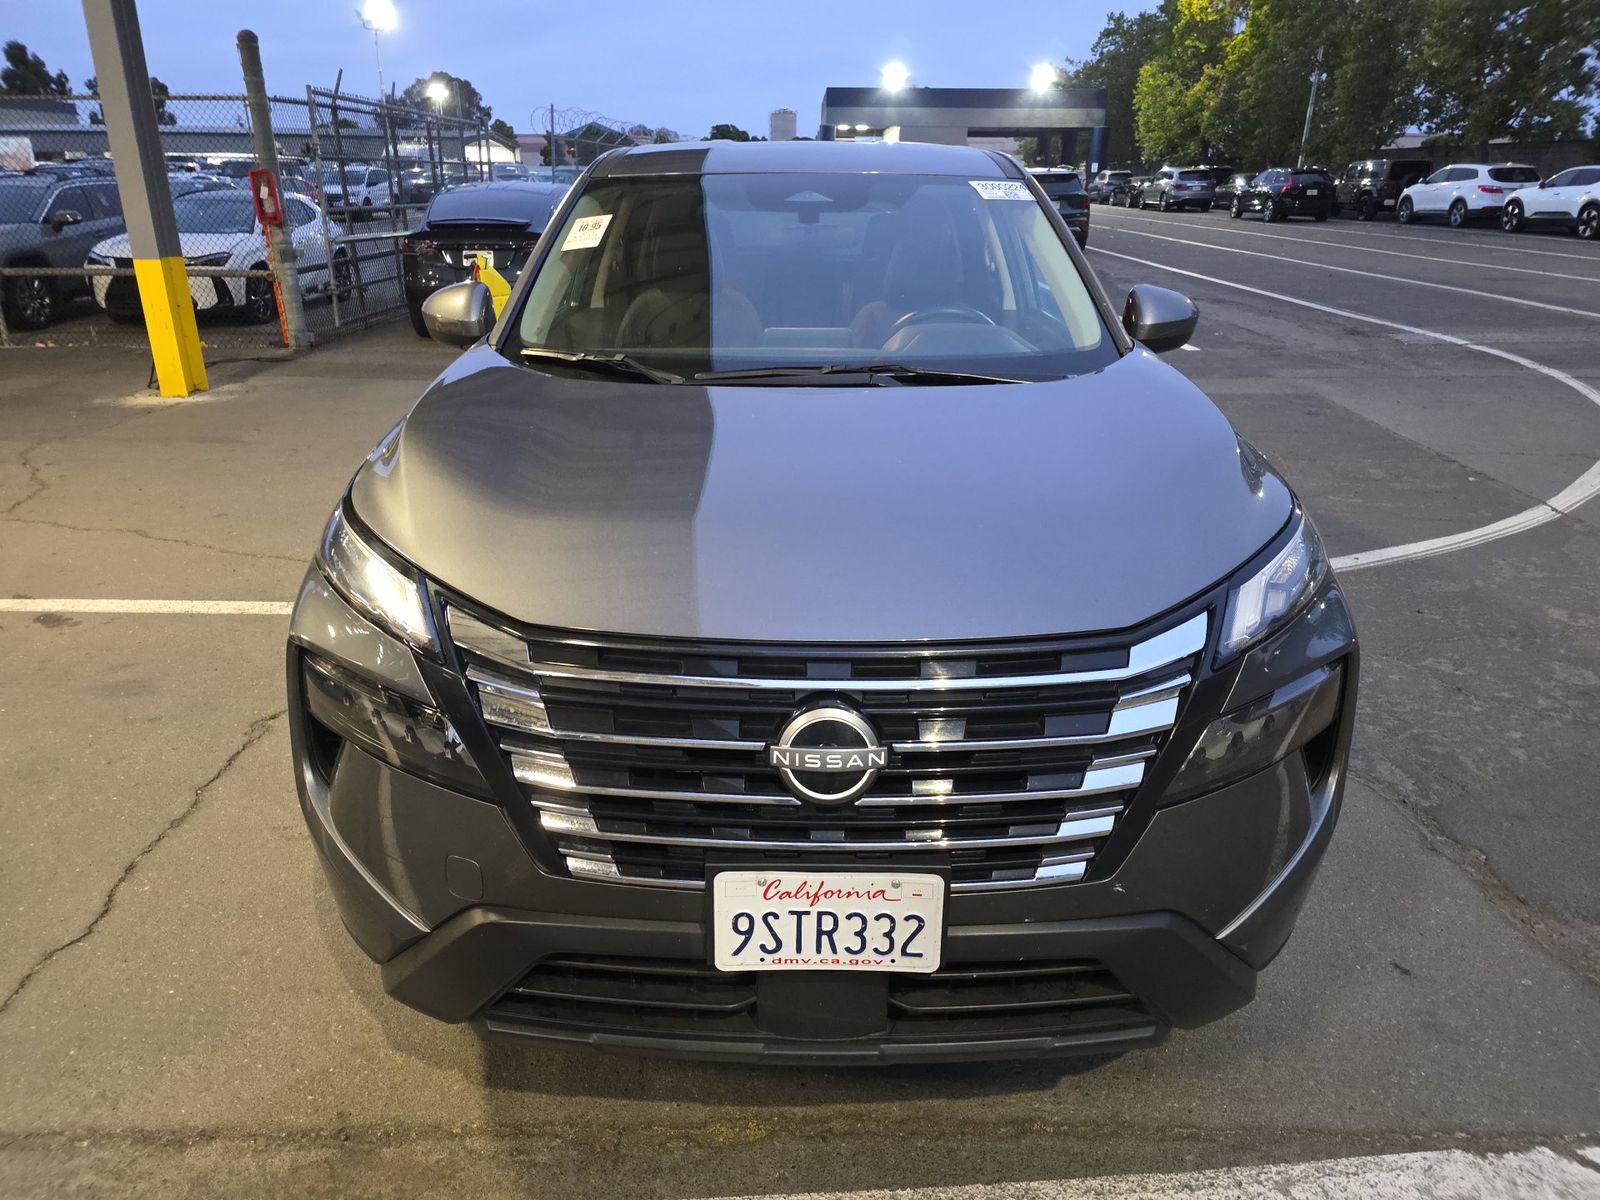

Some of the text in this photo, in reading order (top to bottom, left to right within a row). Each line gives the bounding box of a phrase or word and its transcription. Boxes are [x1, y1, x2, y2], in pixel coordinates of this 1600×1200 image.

[772, 750, 885, 769] NISSAN
[762, 878, 901, 907] California
[731, 909, 926, 958] 9STR332
[771, 956, 885, 966] dmv.ca.gov
